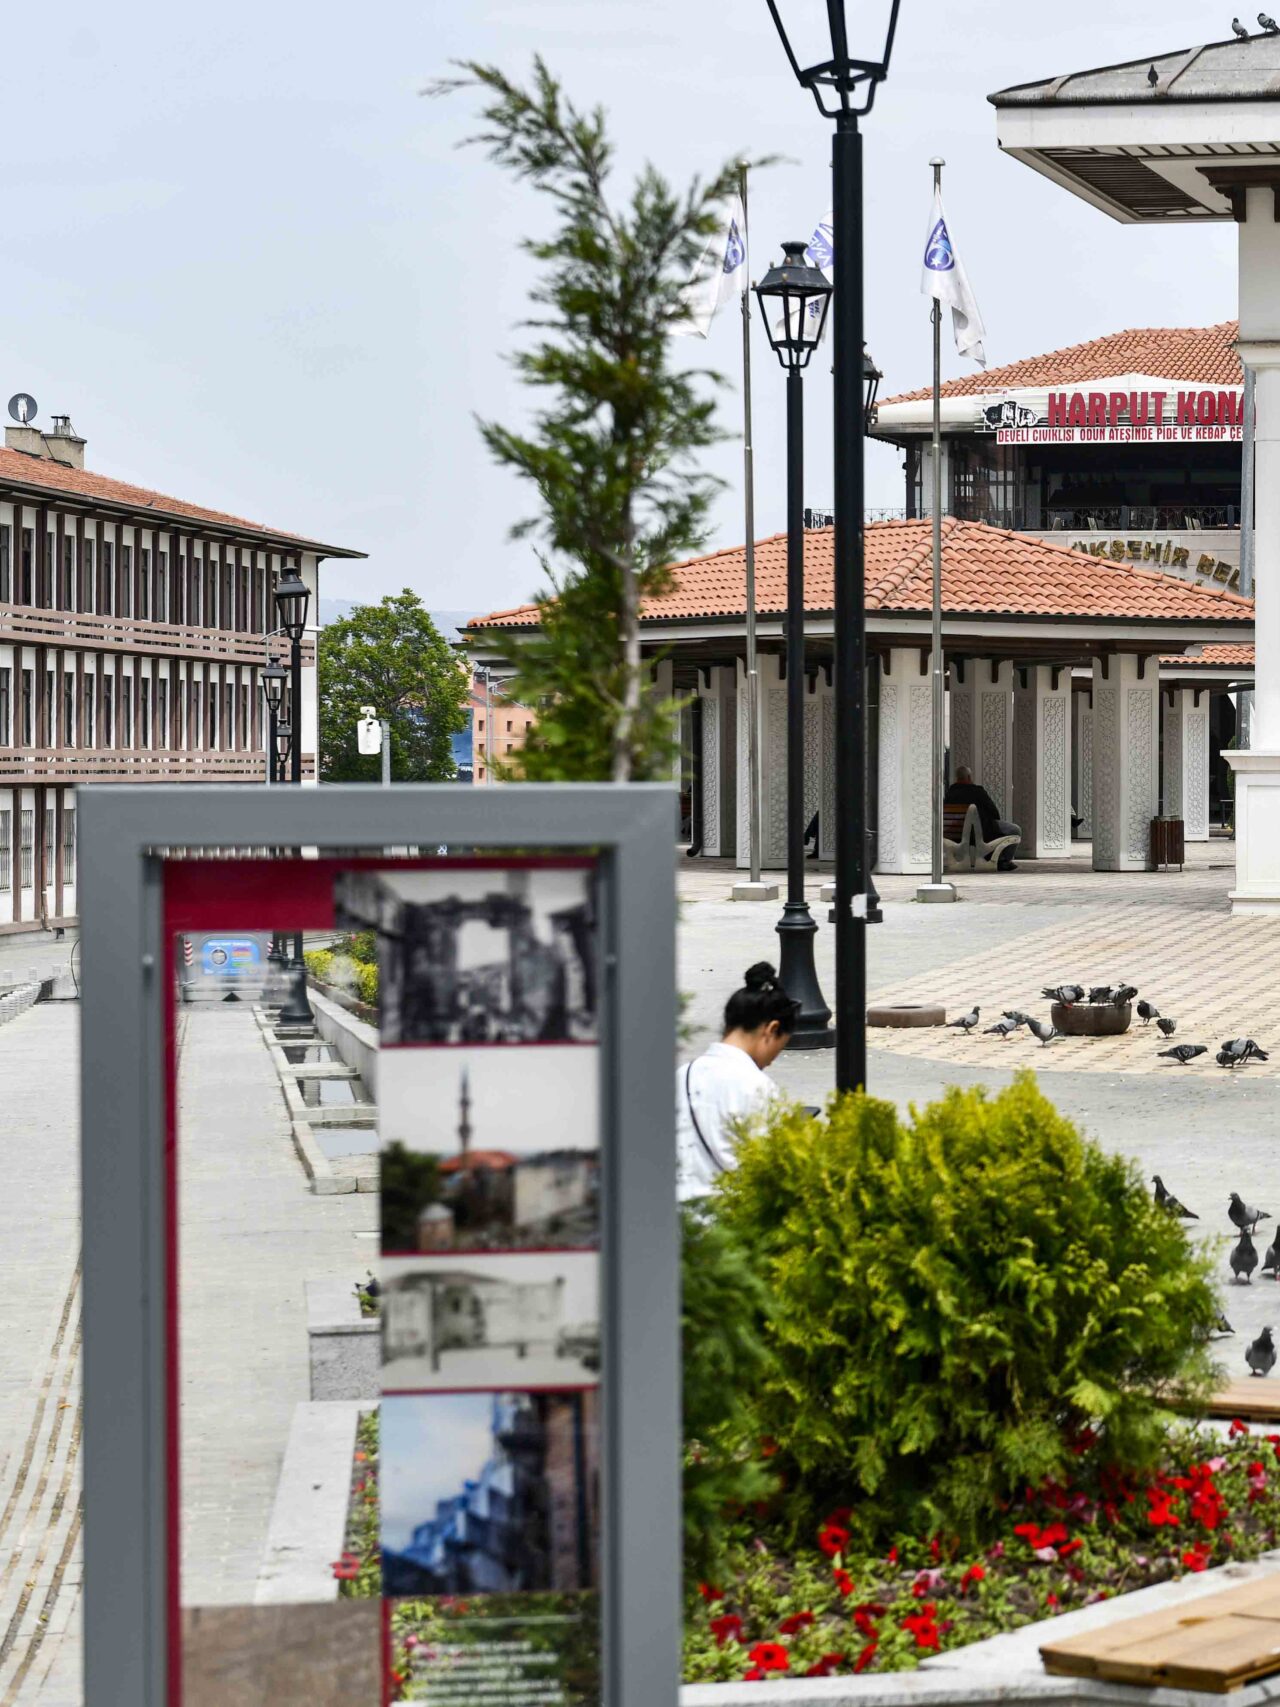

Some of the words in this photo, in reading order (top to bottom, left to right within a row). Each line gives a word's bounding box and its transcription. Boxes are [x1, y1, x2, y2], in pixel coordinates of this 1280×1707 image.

[1048, 391, 1168, 427] HARPUT
[998, 428, 1029, 443] DEVELİ
[1080, 427, 1106, 441] ODUN
[1108, 426, 1154, 443] ATEŞİNDE
[1156, 425, 1178, 441] PİDE
[1181, 426, 1193, 440] VE
[1195, 425, 1227, 440] KEBAP
[1196, 553, 1256, 597] BEL
